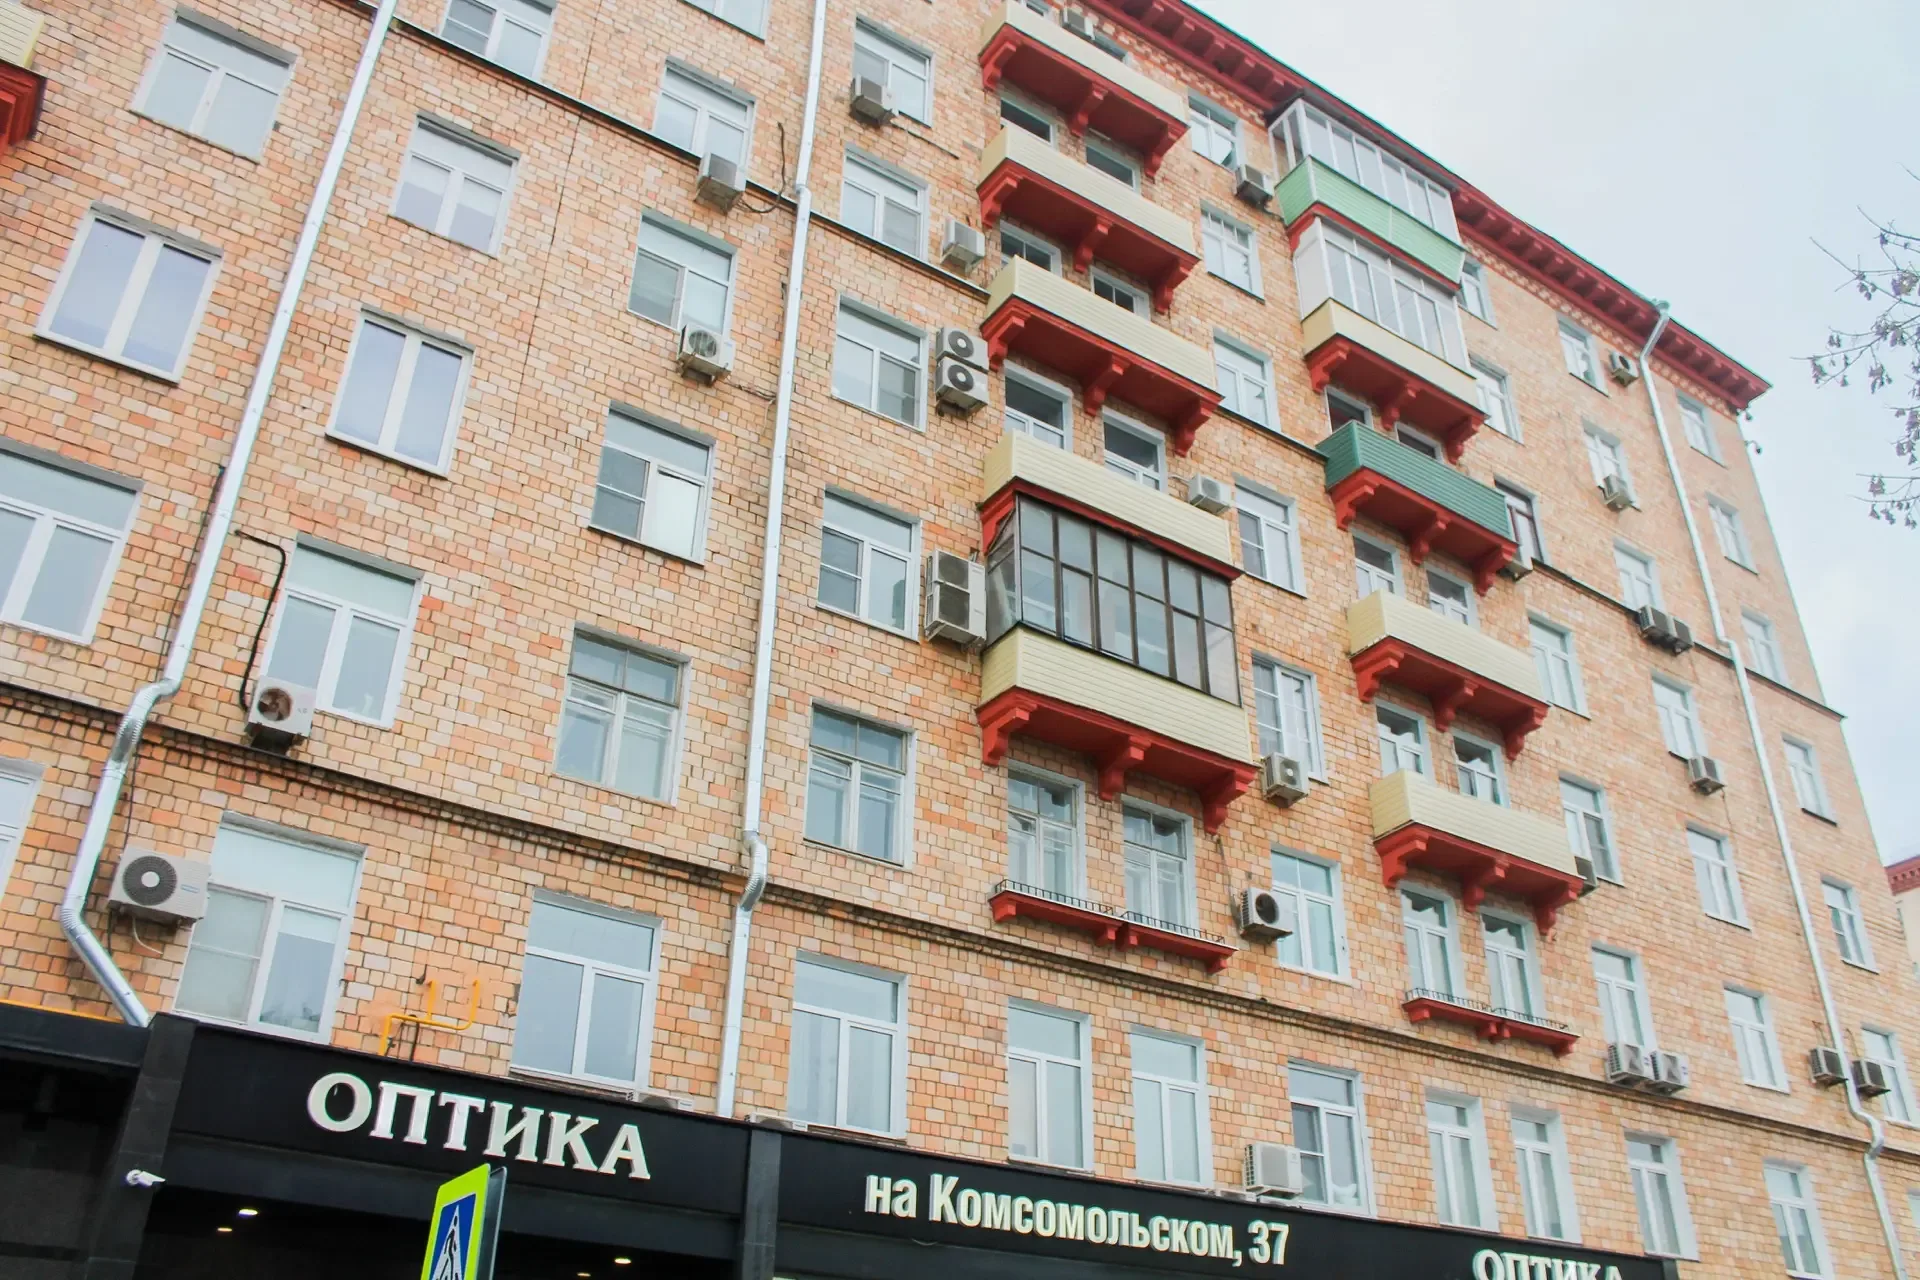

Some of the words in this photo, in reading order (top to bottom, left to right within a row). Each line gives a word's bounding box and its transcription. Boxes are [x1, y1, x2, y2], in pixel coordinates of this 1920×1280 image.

[307, 1072, 651, 1179] ОПТИКА
[865, 1174, 918, 1218] на
[929, 1173, 1242, 1267] Комсомольском,
[1248, 1220, 1290, 1265] 37
